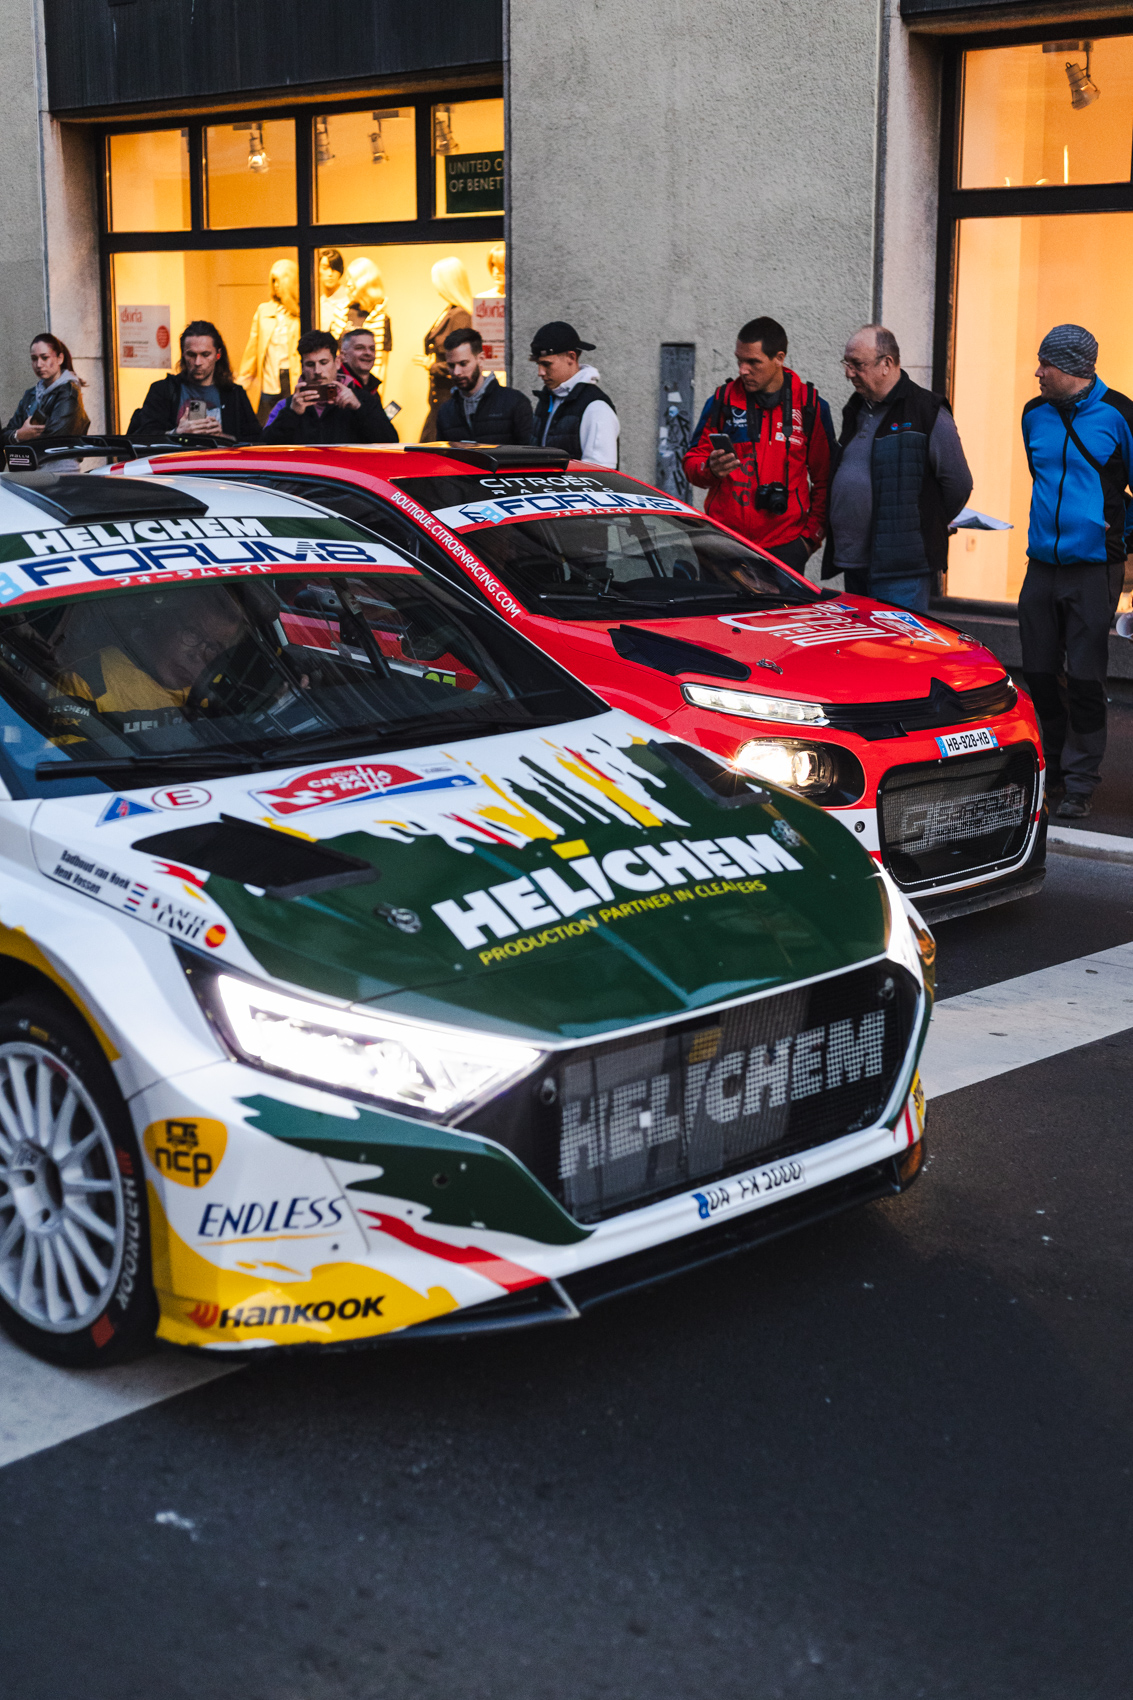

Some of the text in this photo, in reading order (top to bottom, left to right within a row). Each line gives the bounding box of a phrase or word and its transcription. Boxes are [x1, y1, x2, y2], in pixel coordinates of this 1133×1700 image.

[449, 159, 492, 175] UNITED
[449, 179, 465, 192] OF
[493, 493, 683, 516] FORUM8
[18, 541, 378, 587] FORUM8
[390, 491, 522, 618] BOUTIQUE.CITROENRACING.COM
[114, 564, 272, 587] フォーラムエイト
[946, 731, 991, 753] HB-928-KB
[165, 789, 199, 806] E
[479, 913, 600, 966] PRODUCTION
[599, 890, 675, 923] PARTNER
[674, 887, 696, 903] IN
[154, 1147, 213, 1187] ncp
[707, 1187, 731, 1211] DA
[197, 1195, 348, 1238] ENDLESS
